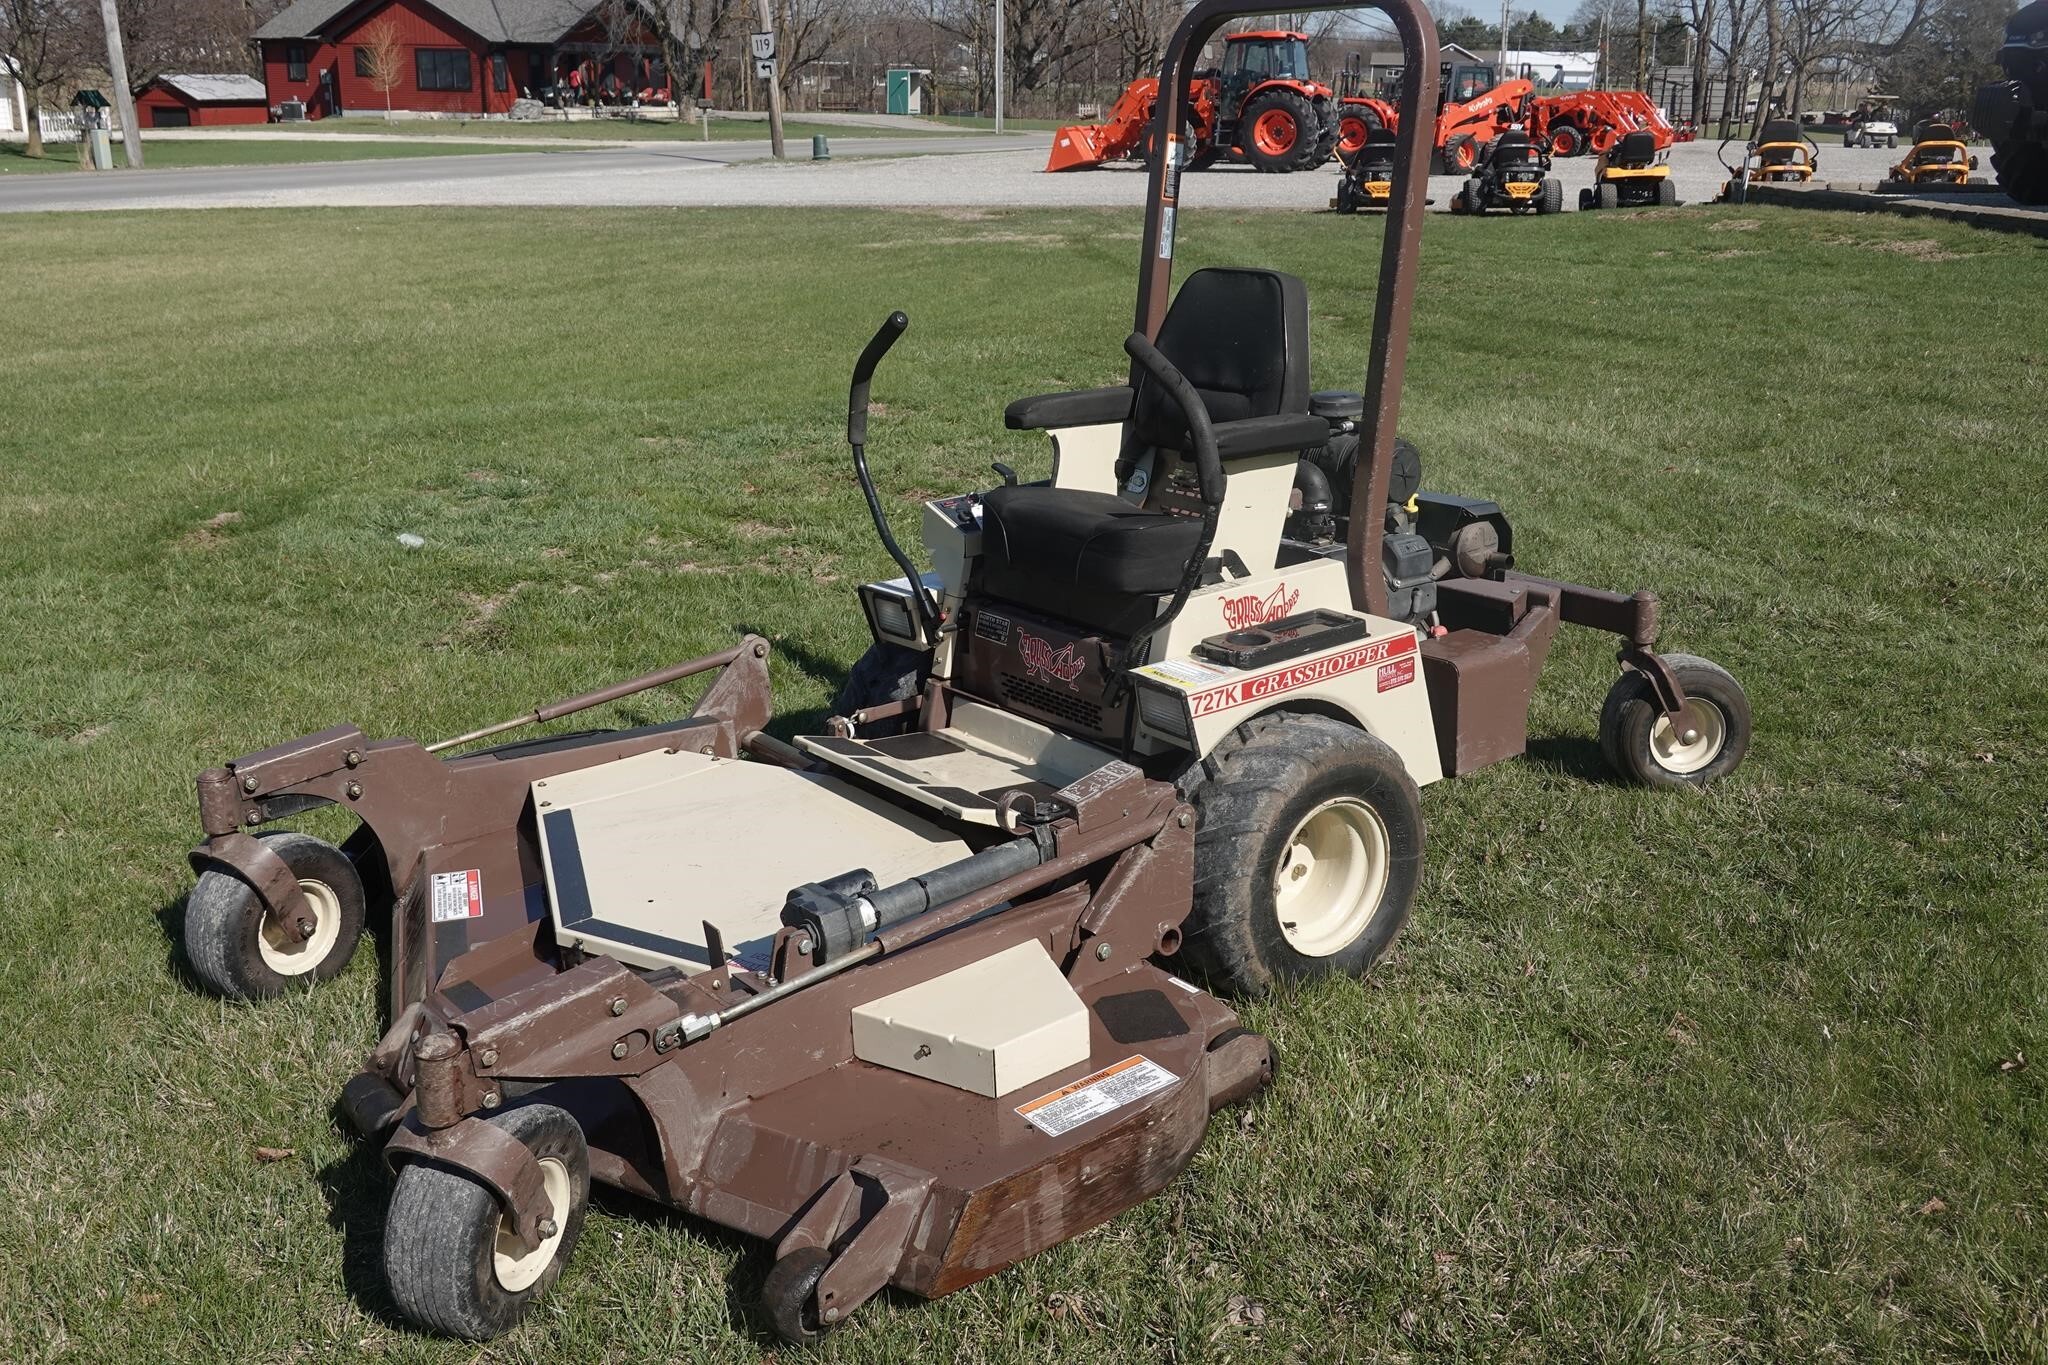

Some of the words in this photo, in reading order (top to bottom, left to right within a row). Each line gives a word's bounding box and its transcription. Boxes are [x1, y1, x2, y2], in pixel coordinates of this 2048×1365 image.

[755, 38, 770, 51] 119
[1468, 97, 1493, 112] Kubota
[1378, 664, 1397, 677] HULL
[1192, 685, 1239, 715] 727K
[1251, 642, 1389, 695] GRASSHOPPER
[1072, 1071, 1110, 1090] WARNING
